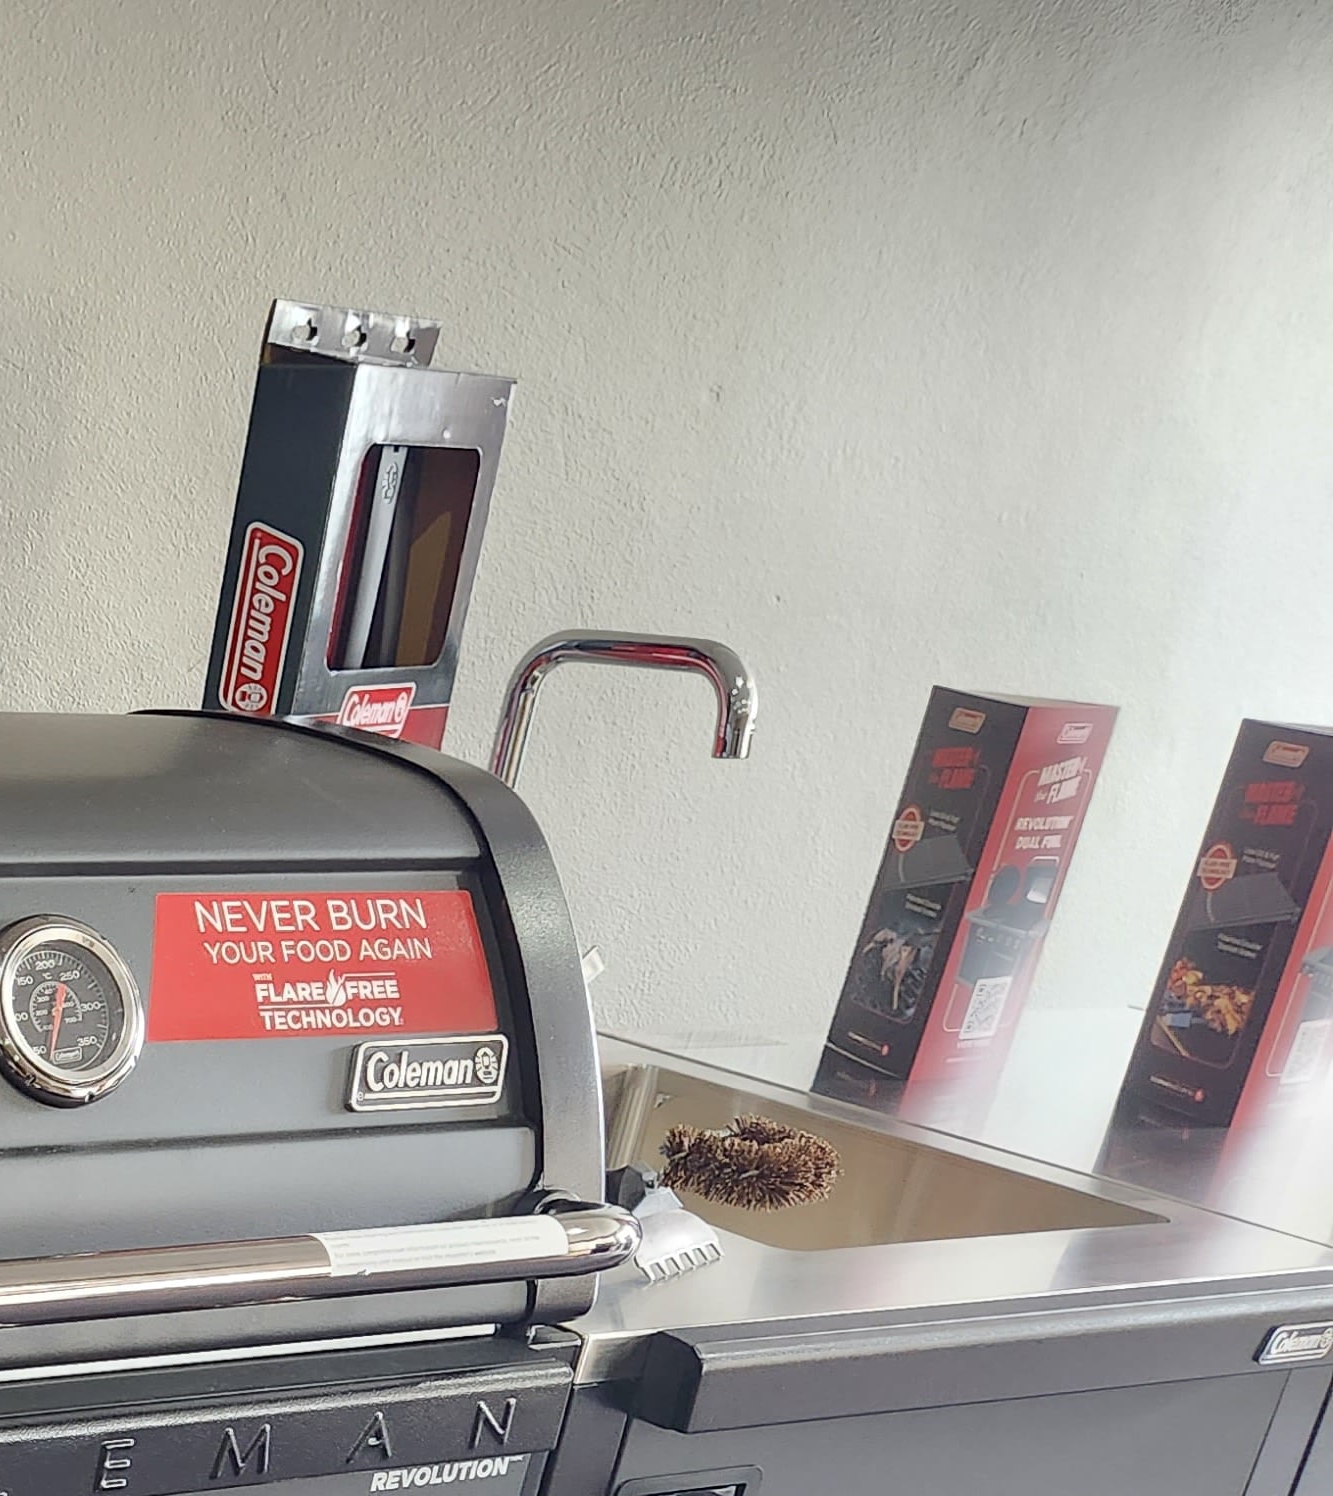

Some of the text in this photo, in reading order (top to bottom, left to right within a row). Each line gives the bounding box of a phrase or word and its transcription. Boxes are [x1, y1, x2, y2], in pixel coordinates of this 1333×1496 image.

[238, 543, 293, 682] Coleman
[344, 693, 396, 727] Coleman
[195, 898, 428, 933] NEVER BURN
[203, 937, 433, 965] YOUR FOOD AGAIN
[35, 960, 55, 970] 200
[59, 970, 80, 981] 250
[253, 973, 272, 982] WITH
[255, 979, 400, 1004] FLARE FREE
[14, 1012, 28, 1022] 00
[80, 1001, 101, 1012] 300
[77, 1036, 98, 1047] 350
[366, 1049, 473, 1091] Coleman
[370, 1457, 509, 1492] REVOLUTION
